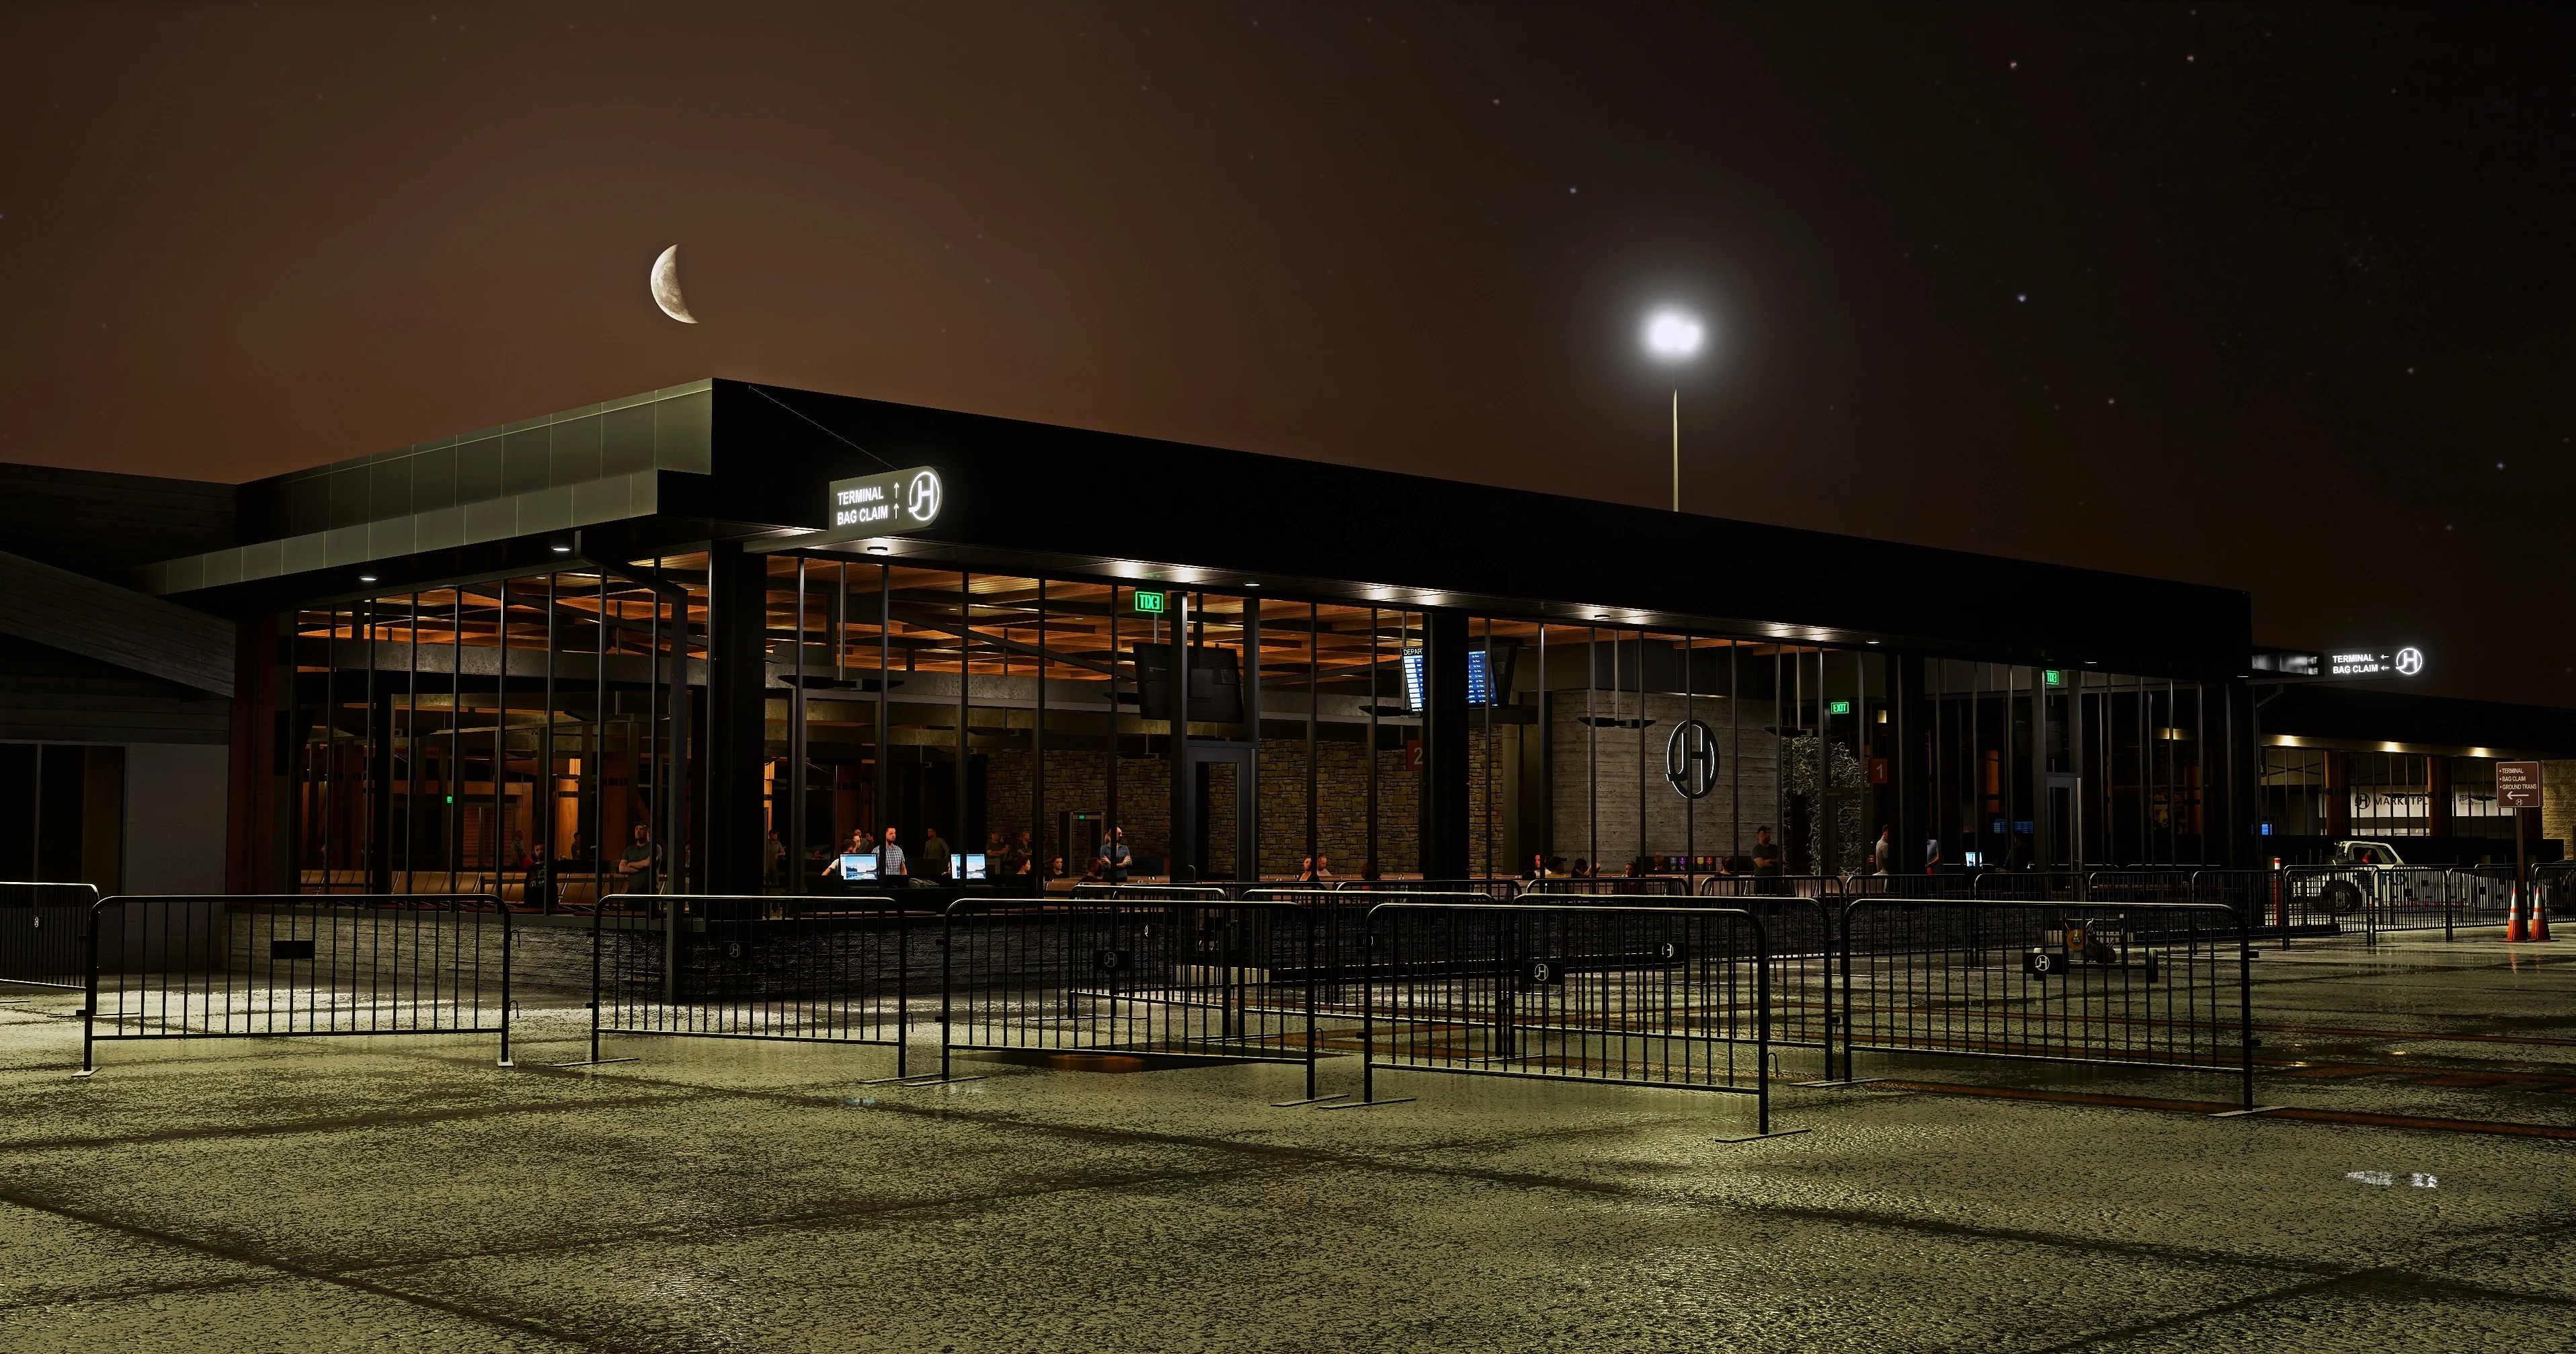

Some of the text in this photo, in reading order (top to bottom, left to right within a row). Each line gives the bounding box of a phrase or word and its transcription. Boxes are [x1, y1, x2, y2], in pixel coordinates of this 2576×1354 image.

[837, 486, 884, 506] TERMINAL
[837, 505, 888, 526] BAG CLAIM
[2332, 653, 2374, 664] TERMINAL
[2333, 664, 2378, 674] BAG CLAIM
[1833, 703, 1847, 713] EXIT
[1414, 747, 1423, 765] 2
[1876, 764, 1883, 779] 1
